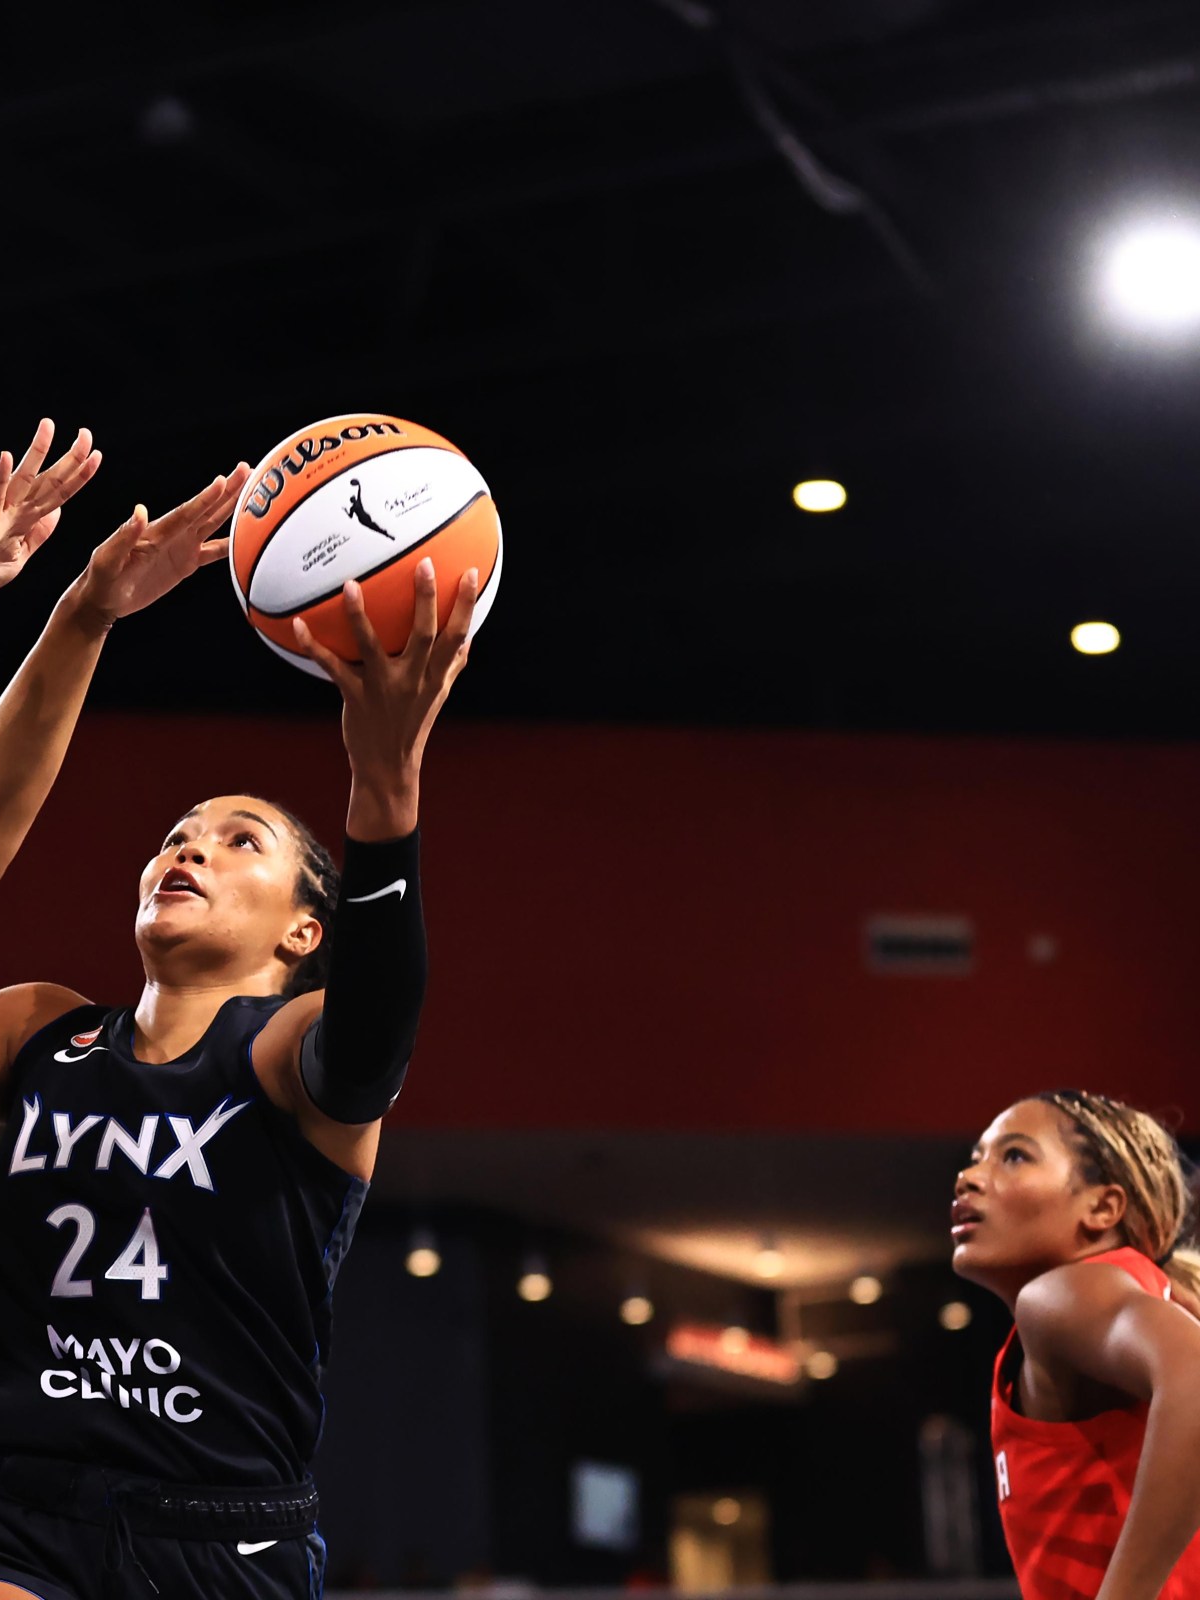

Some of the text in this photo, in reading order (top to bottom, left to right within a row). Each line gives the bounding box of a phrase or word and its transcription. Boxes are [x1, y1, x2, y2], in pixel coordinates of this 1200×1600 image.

[244, 422, 403, 518] Wilson
[302, 533, 340, 561] OFFICIAL
[302, 551, 327, 572] GAME
[327, 536, 350, 554] BALL
[8, 1093, 252, 1192] LYNX
[45, 1204, 168, 1301] 24
[47, 1325, 181, 1375] MAYO
